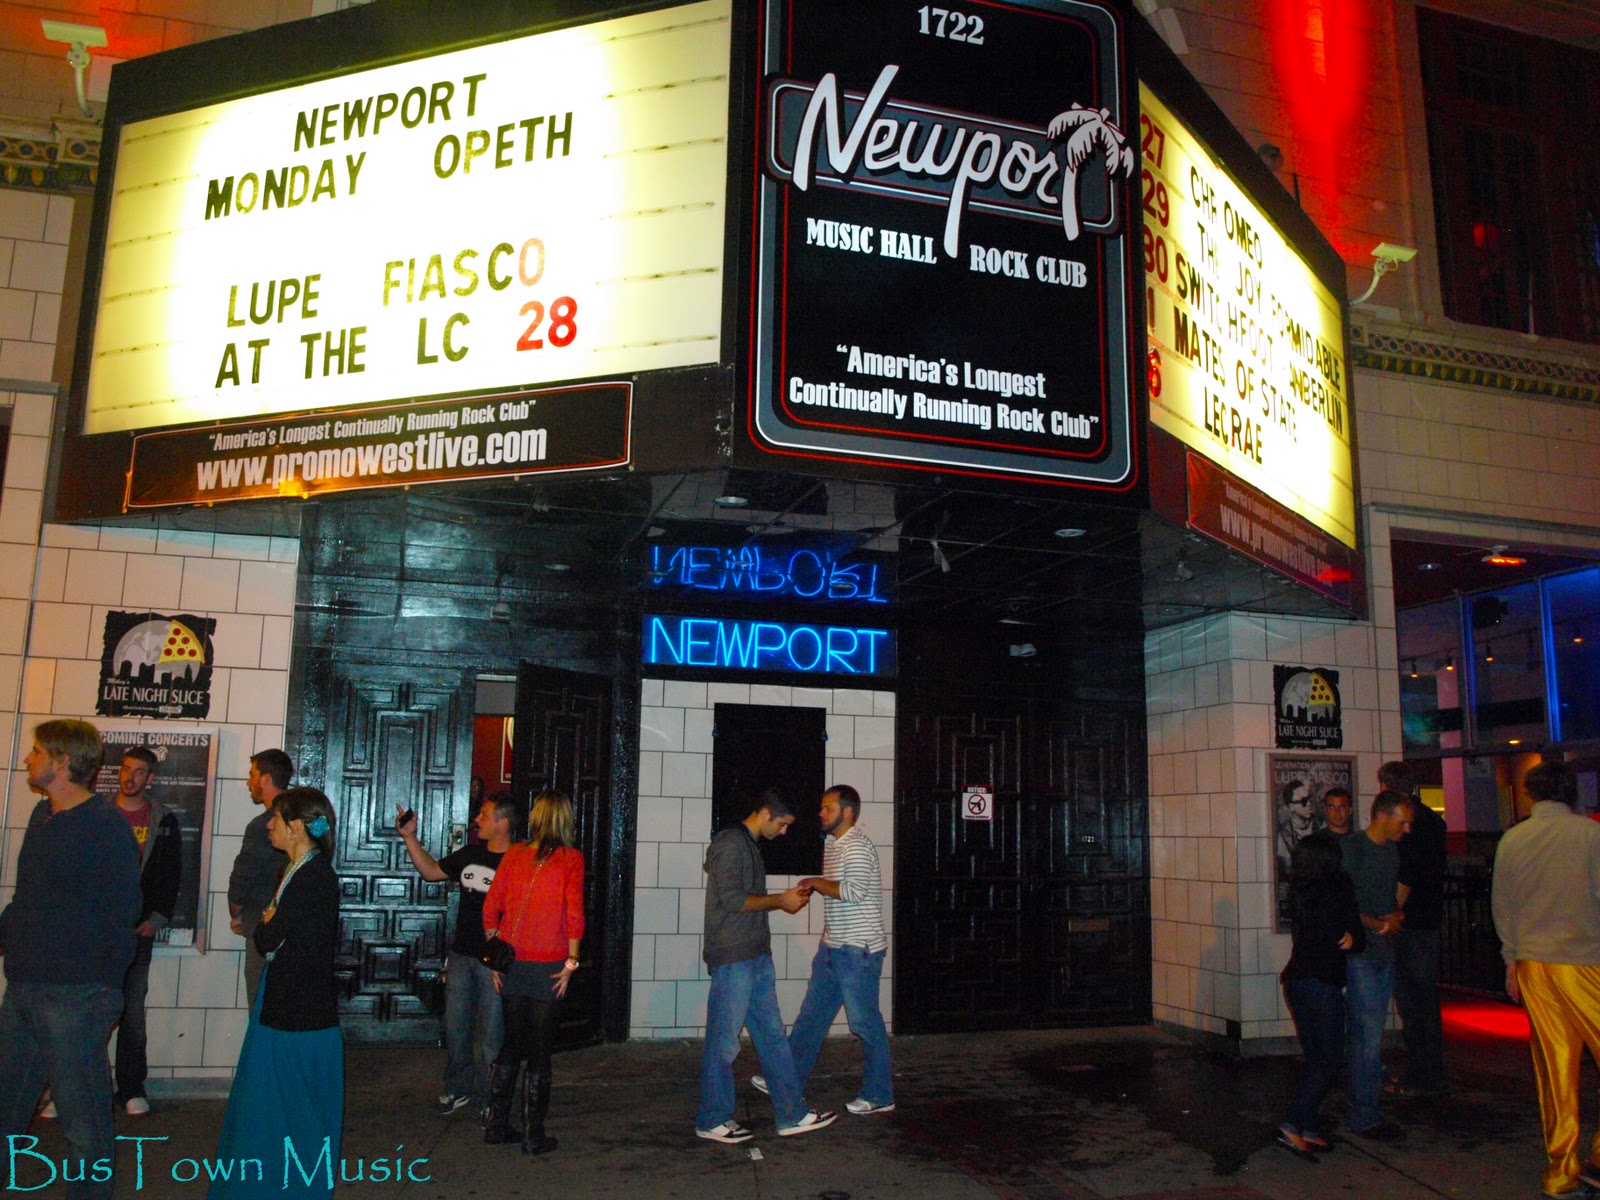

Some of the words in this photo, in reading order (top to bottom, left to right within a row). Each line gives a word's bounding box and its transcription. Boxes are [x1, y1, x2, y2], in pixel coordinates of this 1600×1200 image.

[917, 5, 984, 45] 1722
[293, 73, 487, 152] NEWPORT
[204, 152, 366, 220] MONDAY
[433, 112, 573, 179] OPETH
[793, 65, 1134, 258] Newport
[1140, 112, 1165, 169] 27
[1141, 168, 1169, 228] 29
[806, 218, 873, 253] MUSIC
[880, 230, 937, 264] HALL
[969, 245, 1029, 279] ROCK
[1036, 256, 1087, 288] CLUB
[226, 273, 321, 328] LUPE
[382, 237, 546, 306] FIASCO
[1236, 261, 1261, 313] JOY
[215, 338, 270, 388] AT
[300, 326, 366, 380] THE
[416, 312, 469, 365] LC
[515, 296, 578, 352] 28
[790, 377, 907, 419] Continually
[914, 392, 991, 430] Running
[997, 402, 1045, 434] Rock
[964, 362, 1046, 399] Longest
[1236, 360, 1254, 404] OF
[279, 421, 330, 445] Longest
[333, 413, 403, 440] Continually
[407, 409, 458, 432] Running
[461, 404, 495, 426] Rock
[1204, 386, 1263, 465] LECRAE
[197, 428, 547, 490] www.promowestlive.com
[651, 617, 887, 673] NEWPORT
[103, 685, 130, 700] LATE
[132, 687, 169, 703] NIGHT
[172, 689, 204, 705] SLICE
[148, 733, 209, 747] CONCERTS
[1279, 724, 1294, 736] LATE
[1296, 725, 1317, 738] NIGHT
[1320, 727, 1339, 739] SLICE
[1275, 771, 1307, 784] LUPE
[1308, 771, 1349, 785] FIASCO
